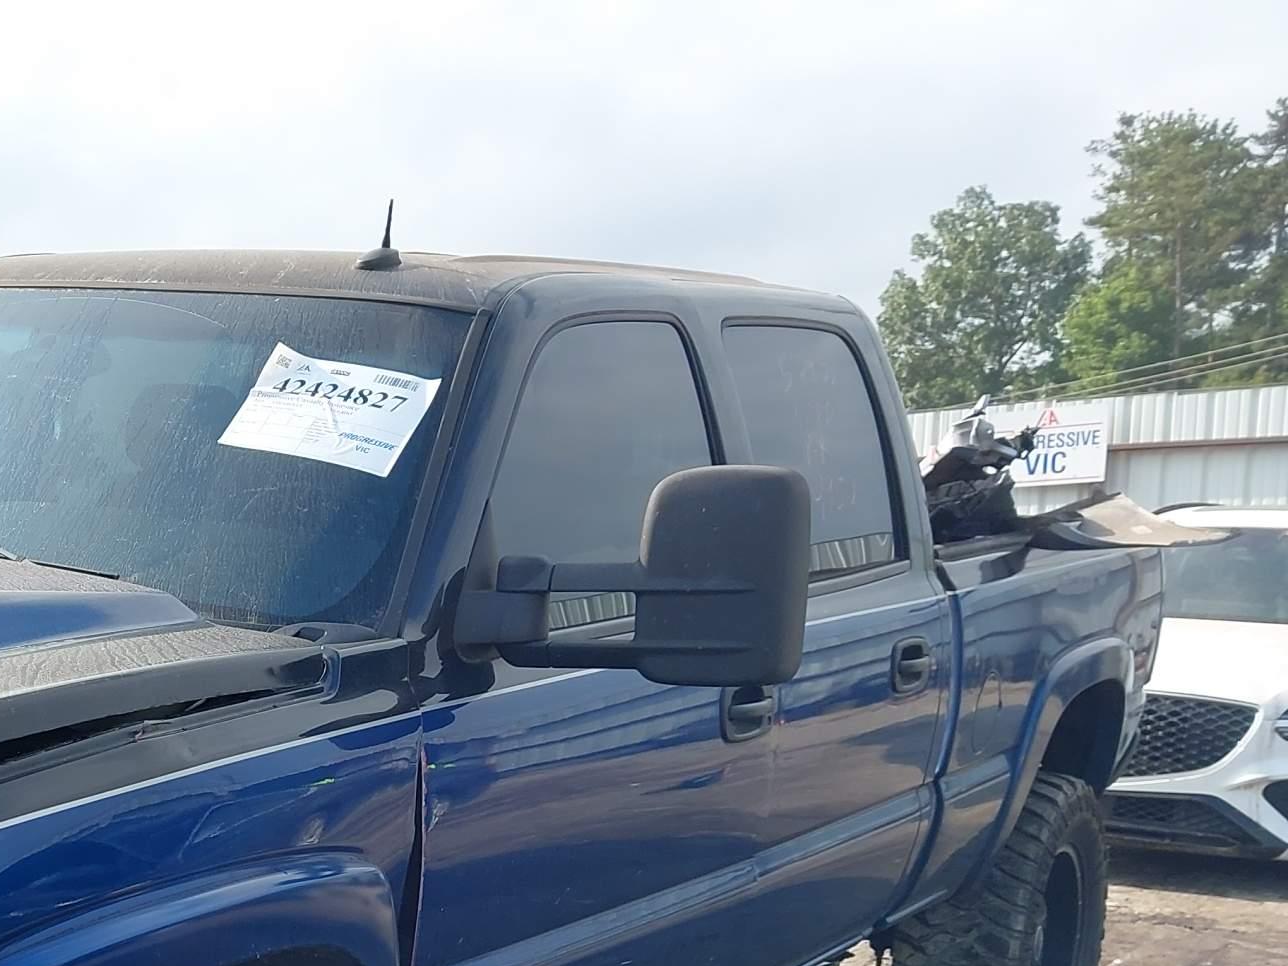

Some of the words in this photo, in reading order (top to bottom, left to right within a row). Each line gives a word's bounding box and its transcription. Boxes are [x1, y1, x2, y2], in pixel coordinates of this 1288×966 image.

[273, 378, 408, 412] 42424827
[355, 445, 370, 453] VIC
[1033, 430, 1100, 449] RESSIVE
[1026, 451, 1067, 475] VIC
